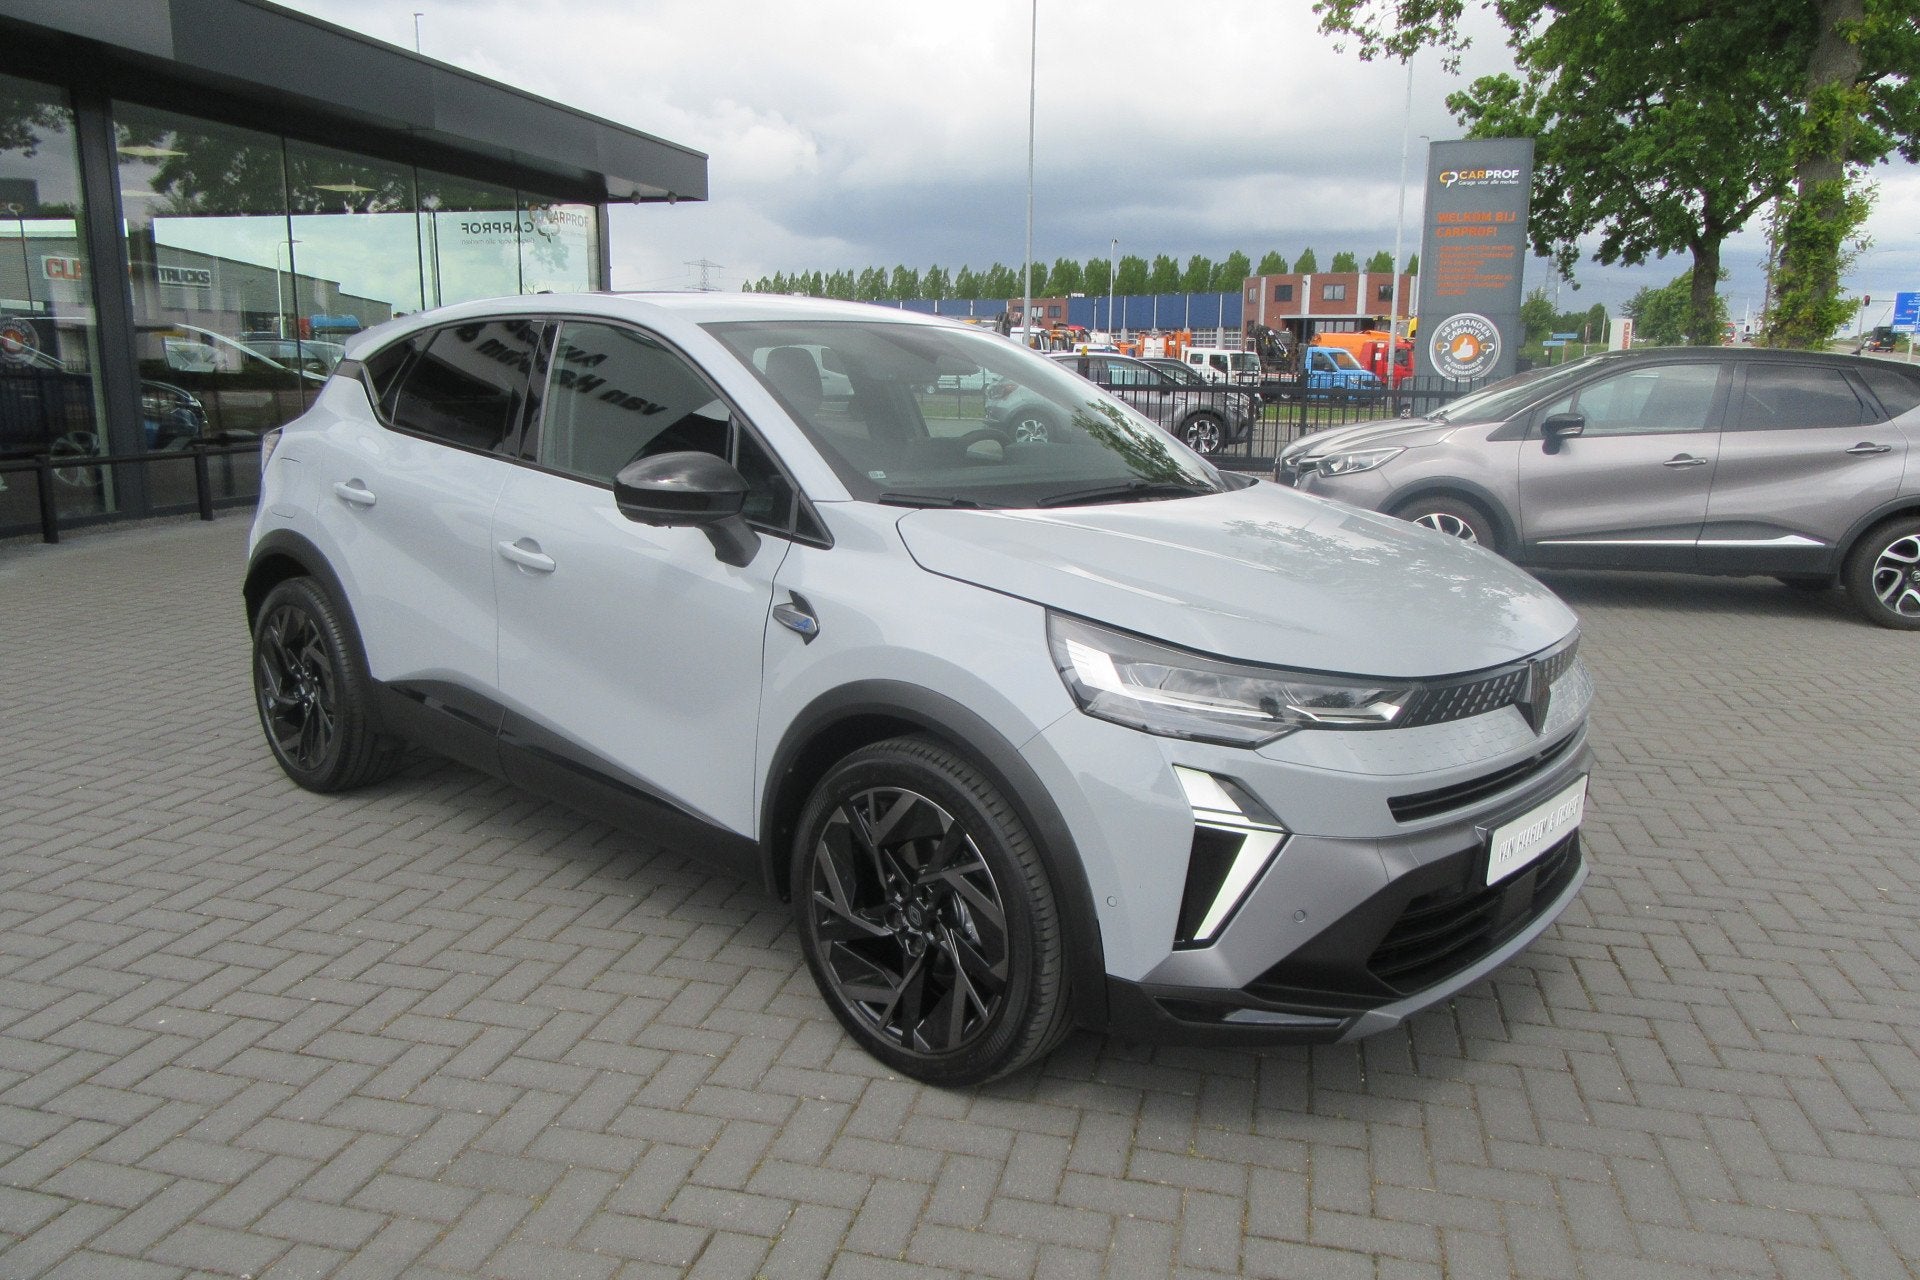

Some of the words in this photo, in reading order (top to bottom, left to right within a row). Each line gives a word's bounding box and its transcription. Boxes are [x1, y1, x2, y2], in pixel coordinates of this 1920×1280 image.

[1459, 169, 1520, 180] CARPROF
[1437, 211, 1492, 223] WELKOM
[1495, 211, 1517, 222] BIJ
[1447, 327, 1485, 341] GARANTIE
[1451, 319, 1491, 337] MAANDEN
